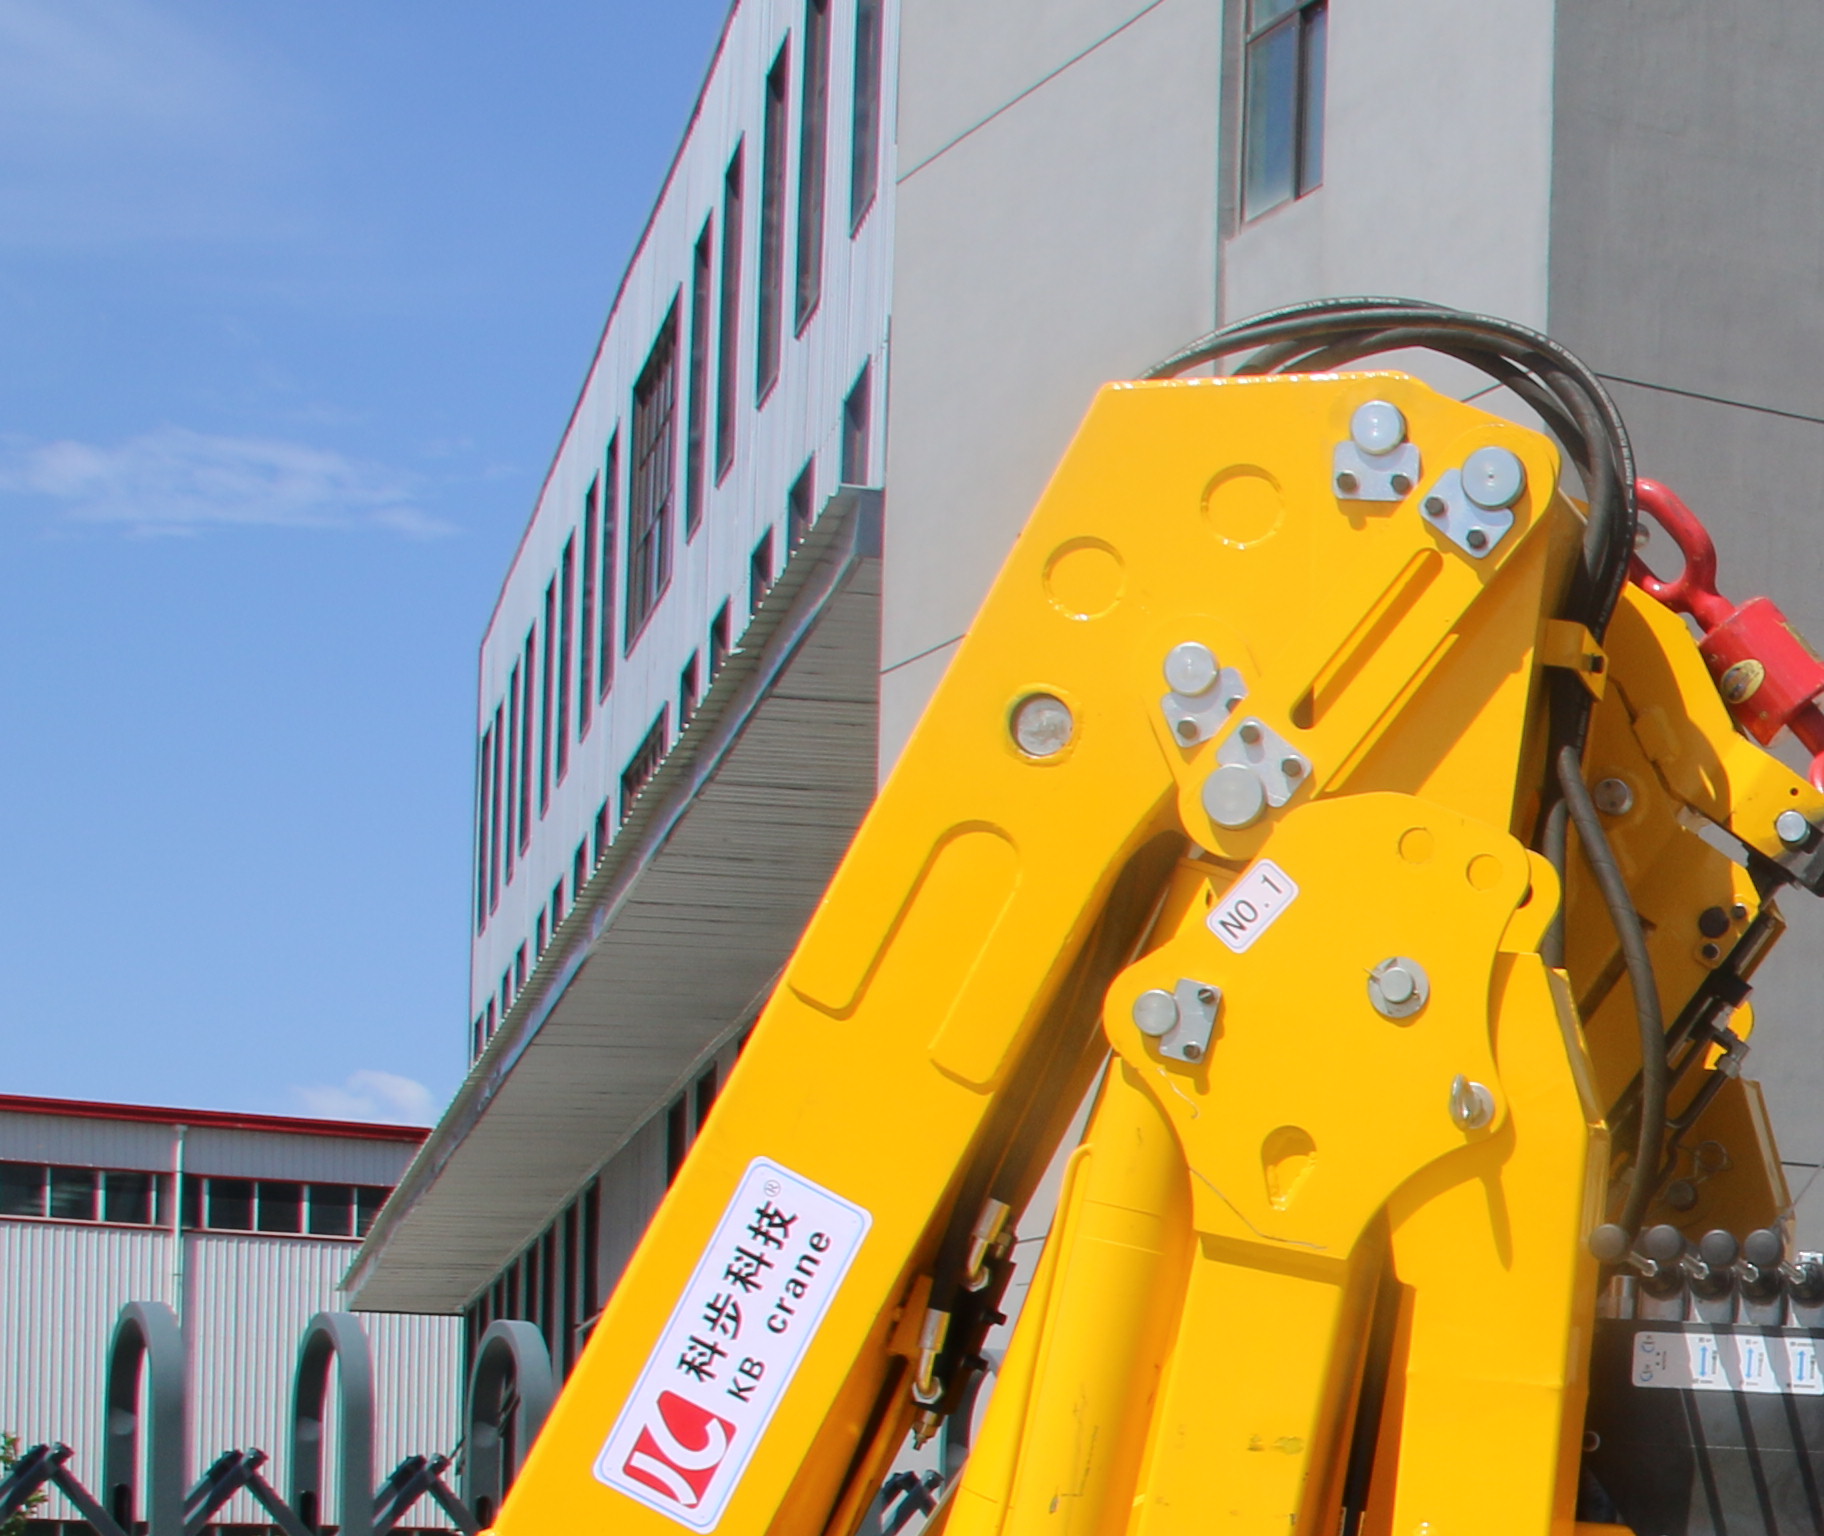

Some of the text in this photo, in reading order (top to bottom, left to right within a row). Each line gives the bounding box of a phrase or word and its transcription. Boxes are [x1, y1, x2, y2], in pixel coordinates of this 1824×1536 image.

[676, 1199, 798, 1383] 科步科技
[726, 1228, 832, 1404] KB crane
